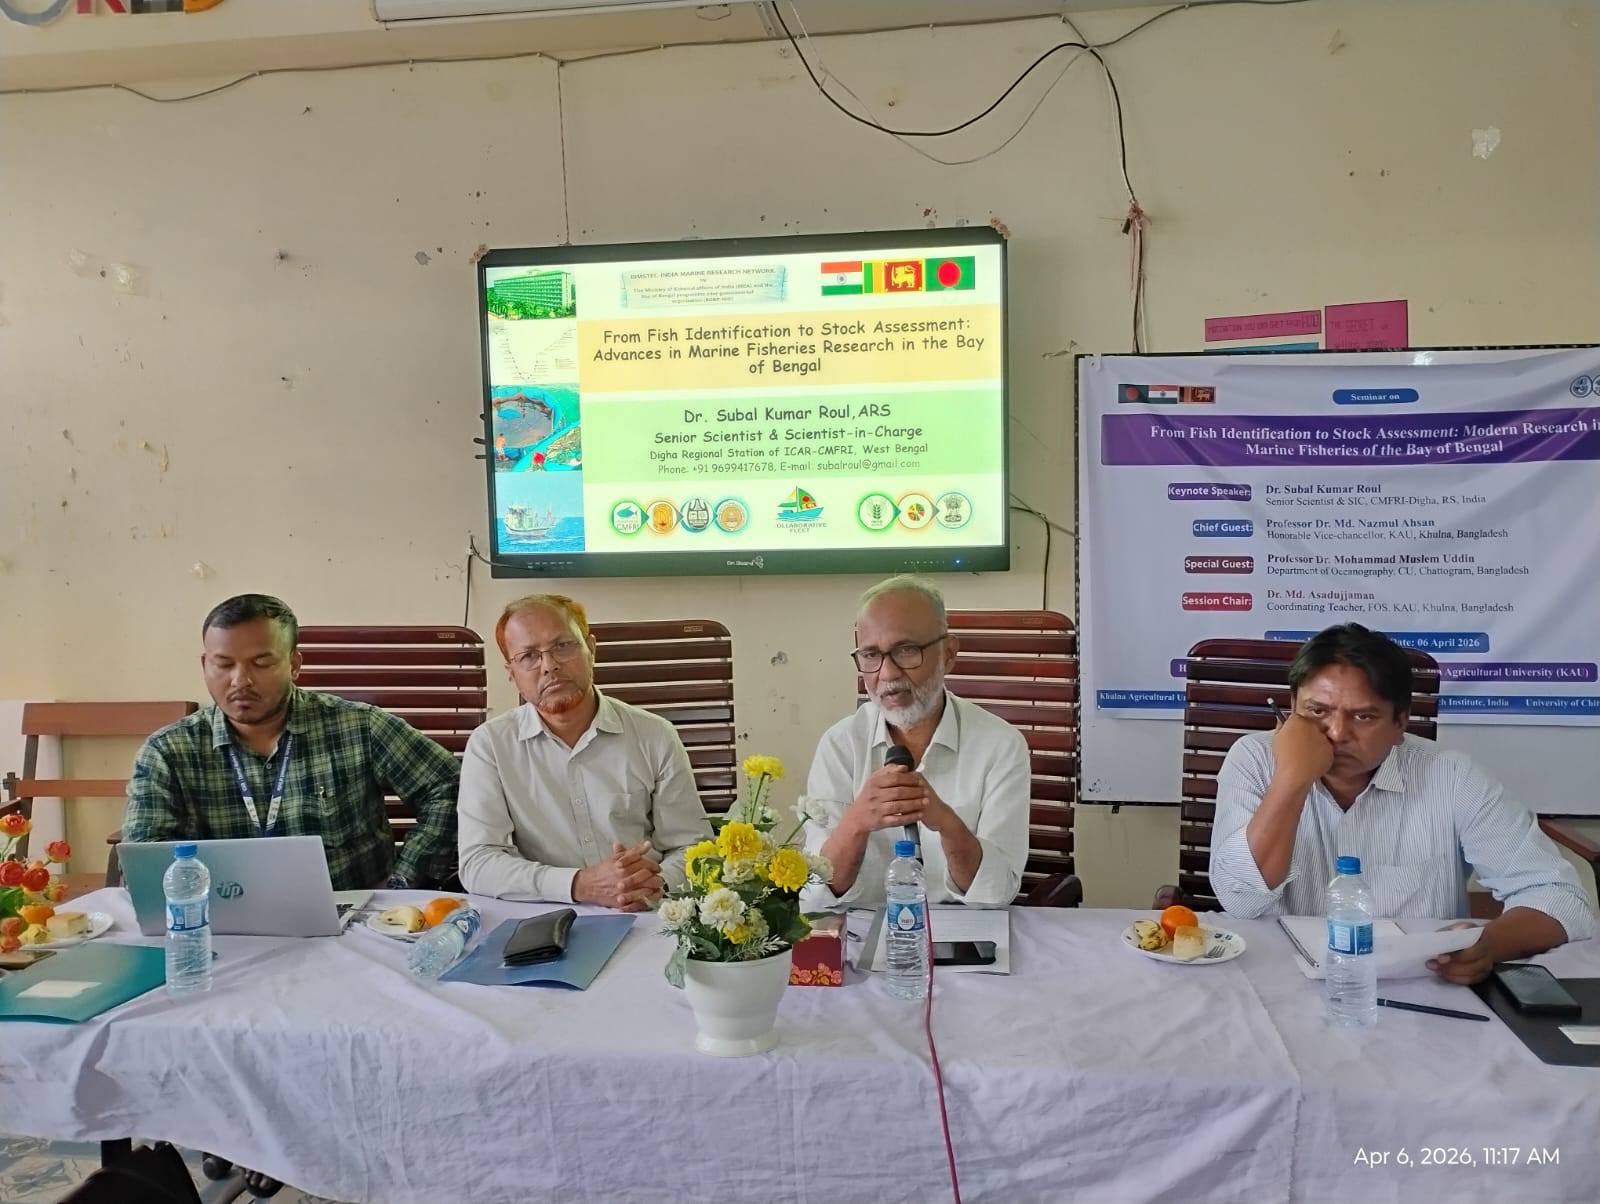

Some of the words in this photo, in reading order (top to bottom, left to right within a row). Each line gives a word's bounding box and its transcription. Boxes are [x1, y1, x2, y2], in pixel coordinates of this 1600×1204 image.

[603, 330, 641, 343] From
[647, 327, 678, 342] Fish
[685, 325, 791, 341] Identification
[798, 323, 814, 336] to
[821, 320, 866, 335] Stock
[873, 317, 971, 333] Assessment:
[593, 347, 662, 362] Advances
[669, 346, 681, 359] in
[688, 344, 740, 359] Marine
[747, 340, 816, 357] Fisheries
[823, 338, 894, 353] Research
[902, 338, 915, 350] in
[922, 336, 948, 350] the
[956, 334, 985, 351] Bay
[749, 360, 765, 374] of
[772, 358, 821, 376] Bengal
[1350, 392, 1387, 401] Seminar
[1388, 392, 1401, 401] on
[684, 409, 708, 423] Dr.
[717, 407, 758, 422] Subal
[765, 406, 812, 420] Kumar
[654, 431, 697, 444] Senior
[703, 429, 763, 443] Scientist
[769, 428, 778, 441] &
[785, 425, 923, 441] Scientist-in-Charge
[1150, 425, 1185, 438] From
[1190, 427, 1217, 439] Fish
[1221, 427, 1311, 440] Identification
[1315, 429, 1329, 440] to
[1333, 427, 1371, 440] Stock
[1375, 426, 1459, 440] Assessment:
[1463, 423, 1517, 438] Modern
[1522, 420, 1588, 435] Research
[649, 450, 678, 462] Digha
[682, 448, 723, 461] Regional
[727, 447, 765, 458] Station
[768, 446, 780, 457] of
[784, 444, 857, 457] ICAR-CMFRI,
[862, 444, 890, 455] West
[895, 442, 929, 456] Bengal
[1246, 443, 1295, 456] Marine
[1299, 444, 1359, 457] Fisheries
[1362, 443, 1379, 457] of
[1380, 443, 1402, 456] the
[1406, 443, 1433, 458] Bay
[1437, 442, 1453, 454] of
[1455, 440, 1504, 455] Bengal
[1168, 487, 1209, 497] Keynote
[1211, 485, 1251, 498] Speaker:
[1266, 485, 1281, 494] Dr.
[1284, 484, 1313, 494] Subal
[1316, 484, 1354, 494] Kumar
[1357, 484, 1382, 494] Roul
[1265, 497, 1293, 506] Senior
[1296, 497, 1334, 506] Scientist
[1336, 497, 1345, 505] &
[1347, 496, 1368, 506] SIC,
[1462, 495, 1487, 504] India
[1193, 524, 1219, 532] Chief
[1221, 524, 1253, 533] Guest:
[1266, 519, 1312, 528] Professor
[1315, 519, 1331, 529] Dr.
[1334, 519, 1356, 528] Md.
[1358, 519, 1399, 528] Nazmul
[1402, 518, 1435, 528] Ahsan
[1267, 531, 1311, 540] Honorable
[1313, 531, 1386, 541] Vice-chancellor,
[1389, 530, 1417, 540] KAU,
[1418, 530, 1454, 540] Khulna,
[1456, 529, 1509, 540] Bangladesh
[1185, 560, 1219, 570] Special
[1221, 559, 1253, 569] Guest:
[1267, 554, 1314, 564] Professor
[1315, 555, 1331, 564] Dr.
[1334, 555, 1396, 564] Mohammad
[1399, 554, 1440, 563] Muslem
[1443, 554, 1475, 563] Uddin
[1267, 566, 1318, 576] Department
[1320, 567, 1330, 575] of
[1477, 565, 1529, 575] Bangladesh
[1182, 596, 1219, 605] Session
[1222, 595, 1251, 606] Chair:
[1267, 589, 1282, 598] Dr.
[1286, 590, 1306, 598] Md.
[1310, 590, 1375, 601] Asadujjaman
[1266, 602, 1325, 613] Coordinating
[1328, 602, 1366, 612] Teacher,
[1422, 603, 1458, 612] Khulna,
[1461, 602, 1514, 613] Bangladesh
[1417, 638, 1429, 647] 06
[1431, 638, 1455, 648] April
[1458, 638, 1480, 647] 2026
[1446, 668, 1501, 678] Agricultural
[1504, 667, 1553, 678] University
[1556, 667, 1589, 679] (KAU)
[1100, 692, 1126, 701] Khulna
[1129, 692, 1175, 702] Agricultural
[1487, 698, 1509, 707] India
[1525, 698, 1568, 708] University
[1570, 699, 1580, 707] of
[216, 880, 244, 903] hp
